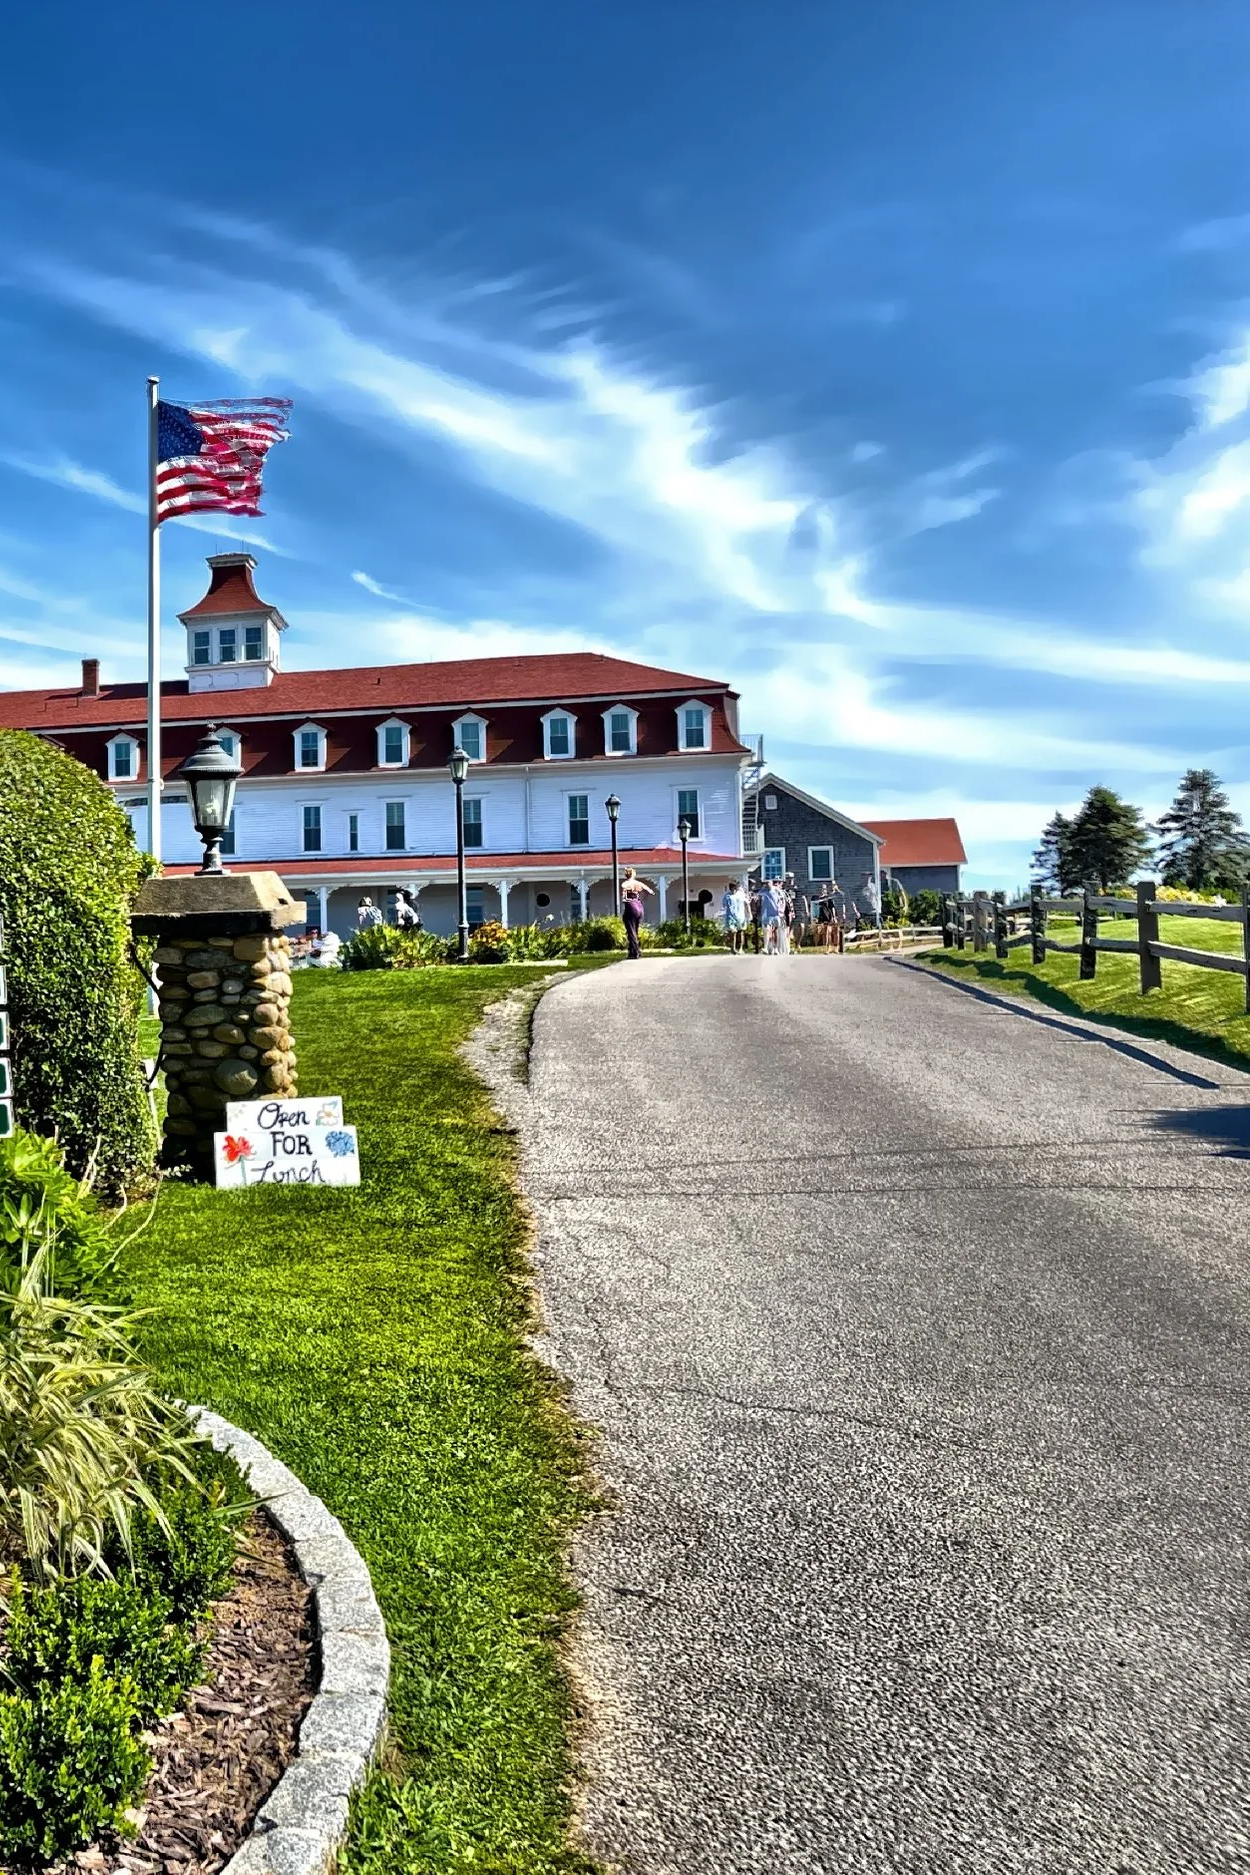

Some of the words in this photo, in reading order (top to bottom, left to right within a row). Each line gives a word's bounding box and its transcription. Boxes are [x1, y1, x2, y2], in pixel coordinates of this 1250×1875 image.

[257, 1102, 310, 1130] Open
[270, 1131, 312, 1157] FOR
[251, 1159, 326, 1184] Lunch
